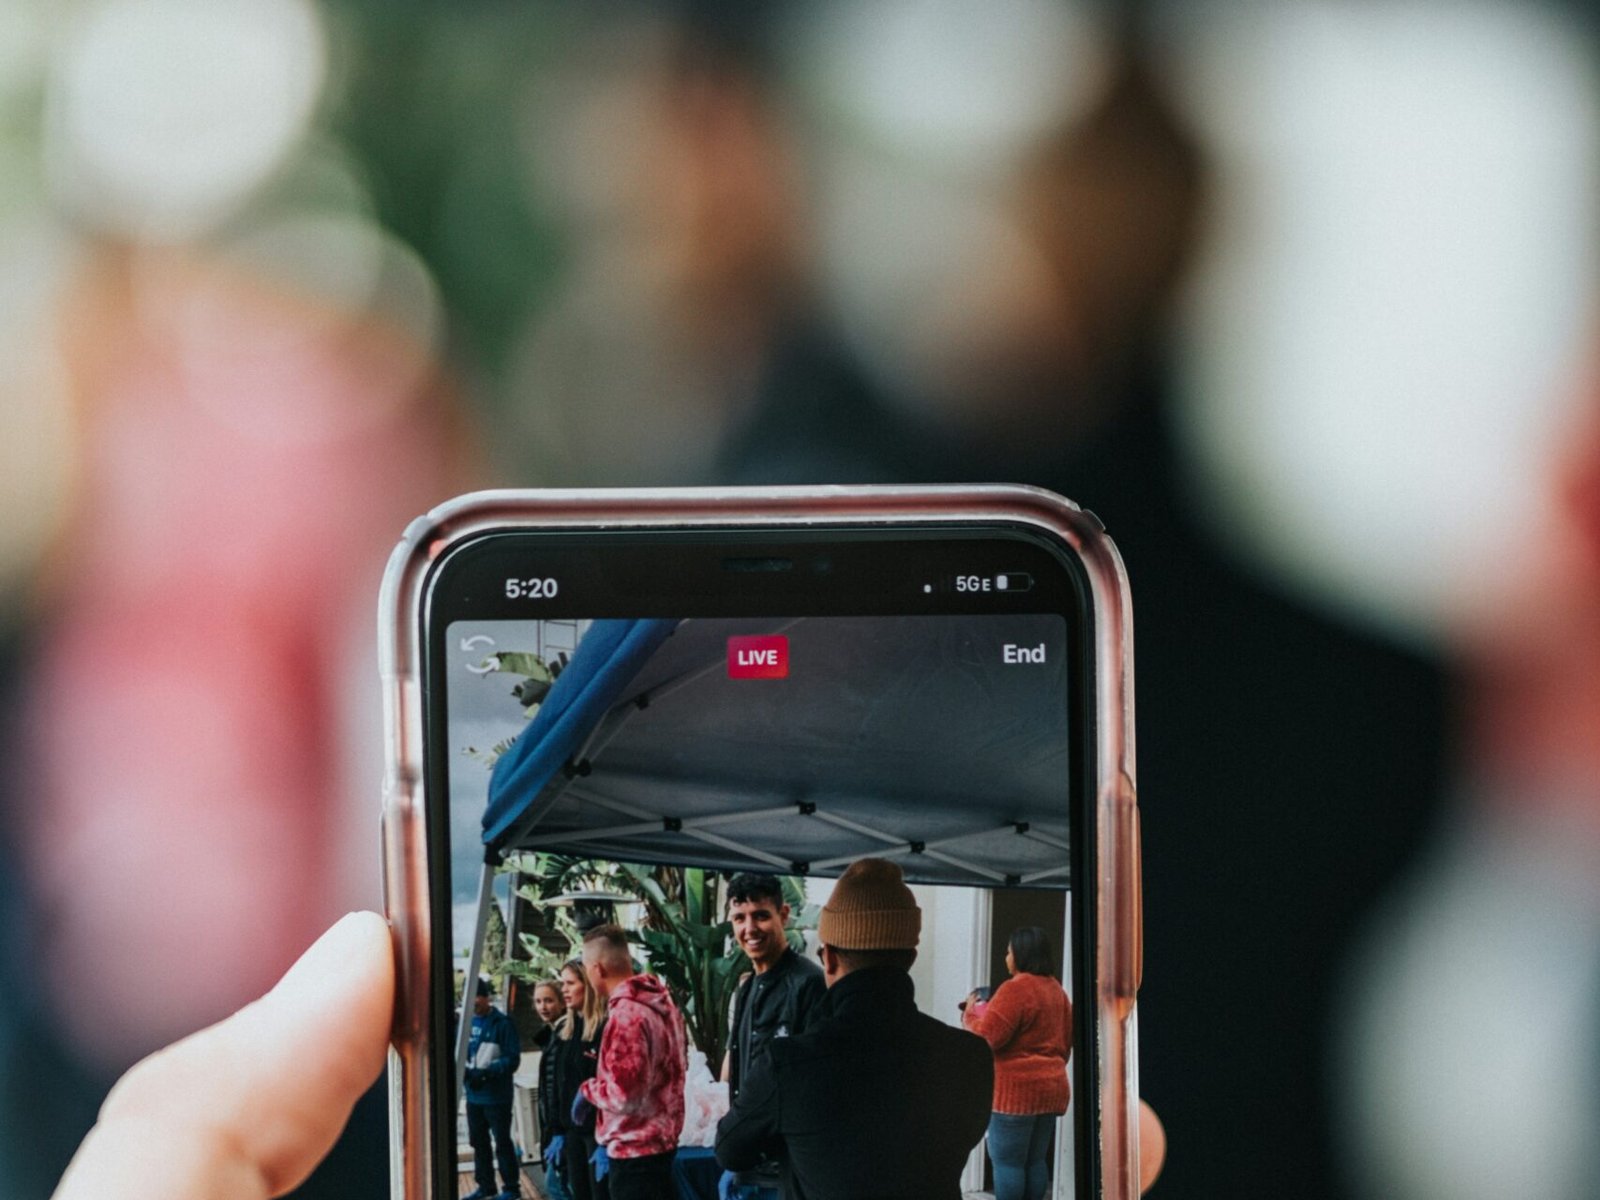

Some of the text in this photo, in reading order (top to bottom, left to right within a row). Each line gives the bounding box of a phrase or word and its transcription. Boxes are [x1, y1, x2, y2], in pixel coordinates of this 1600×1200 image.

[505, 578, 558, 598] 5:20
[738, 650, 778, 665] LIVE
[1003, 643, 1046, 664] End
